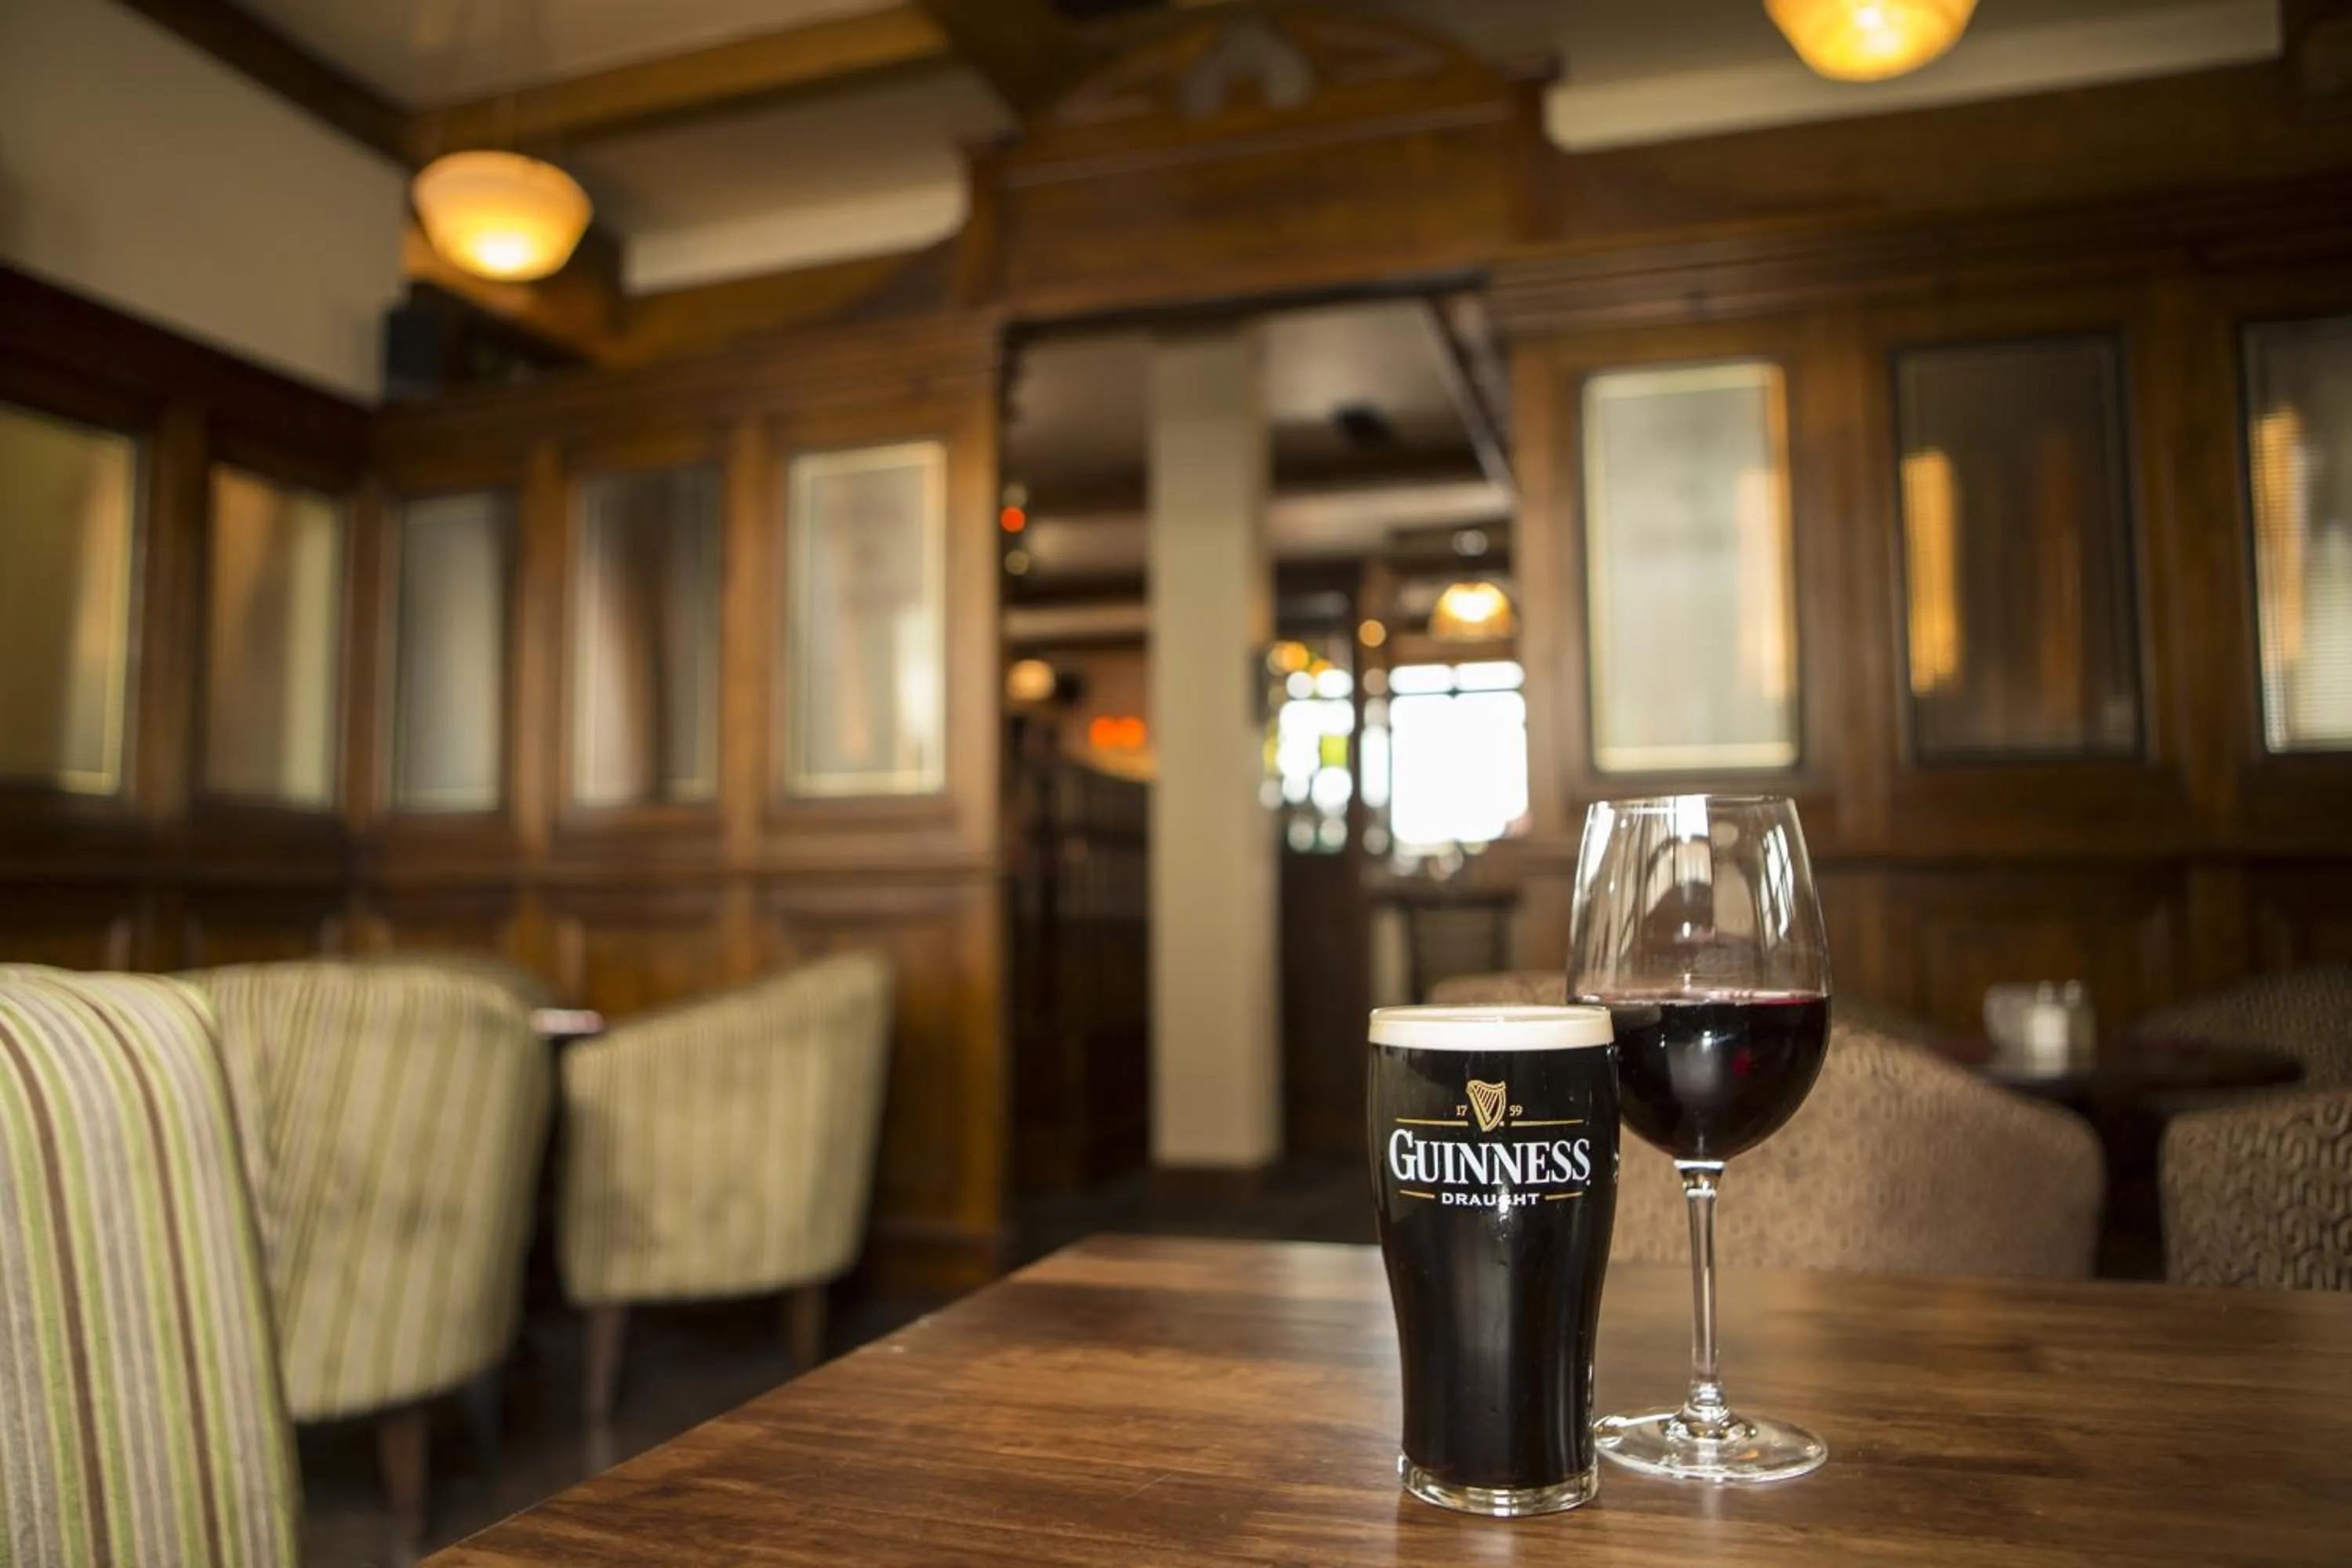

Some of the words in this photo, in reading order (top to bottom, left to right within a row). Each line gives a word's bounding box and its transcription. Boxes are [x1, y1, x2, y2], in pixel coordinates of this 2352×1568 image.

[1456, 1105, 1468, 1116] 17
[1509, 1105, 1523, 1116] 59
[1388, 1128, 1591, 1185] GUINNESS
[1441, 1192, 1540, 1206] DRAUGHT
